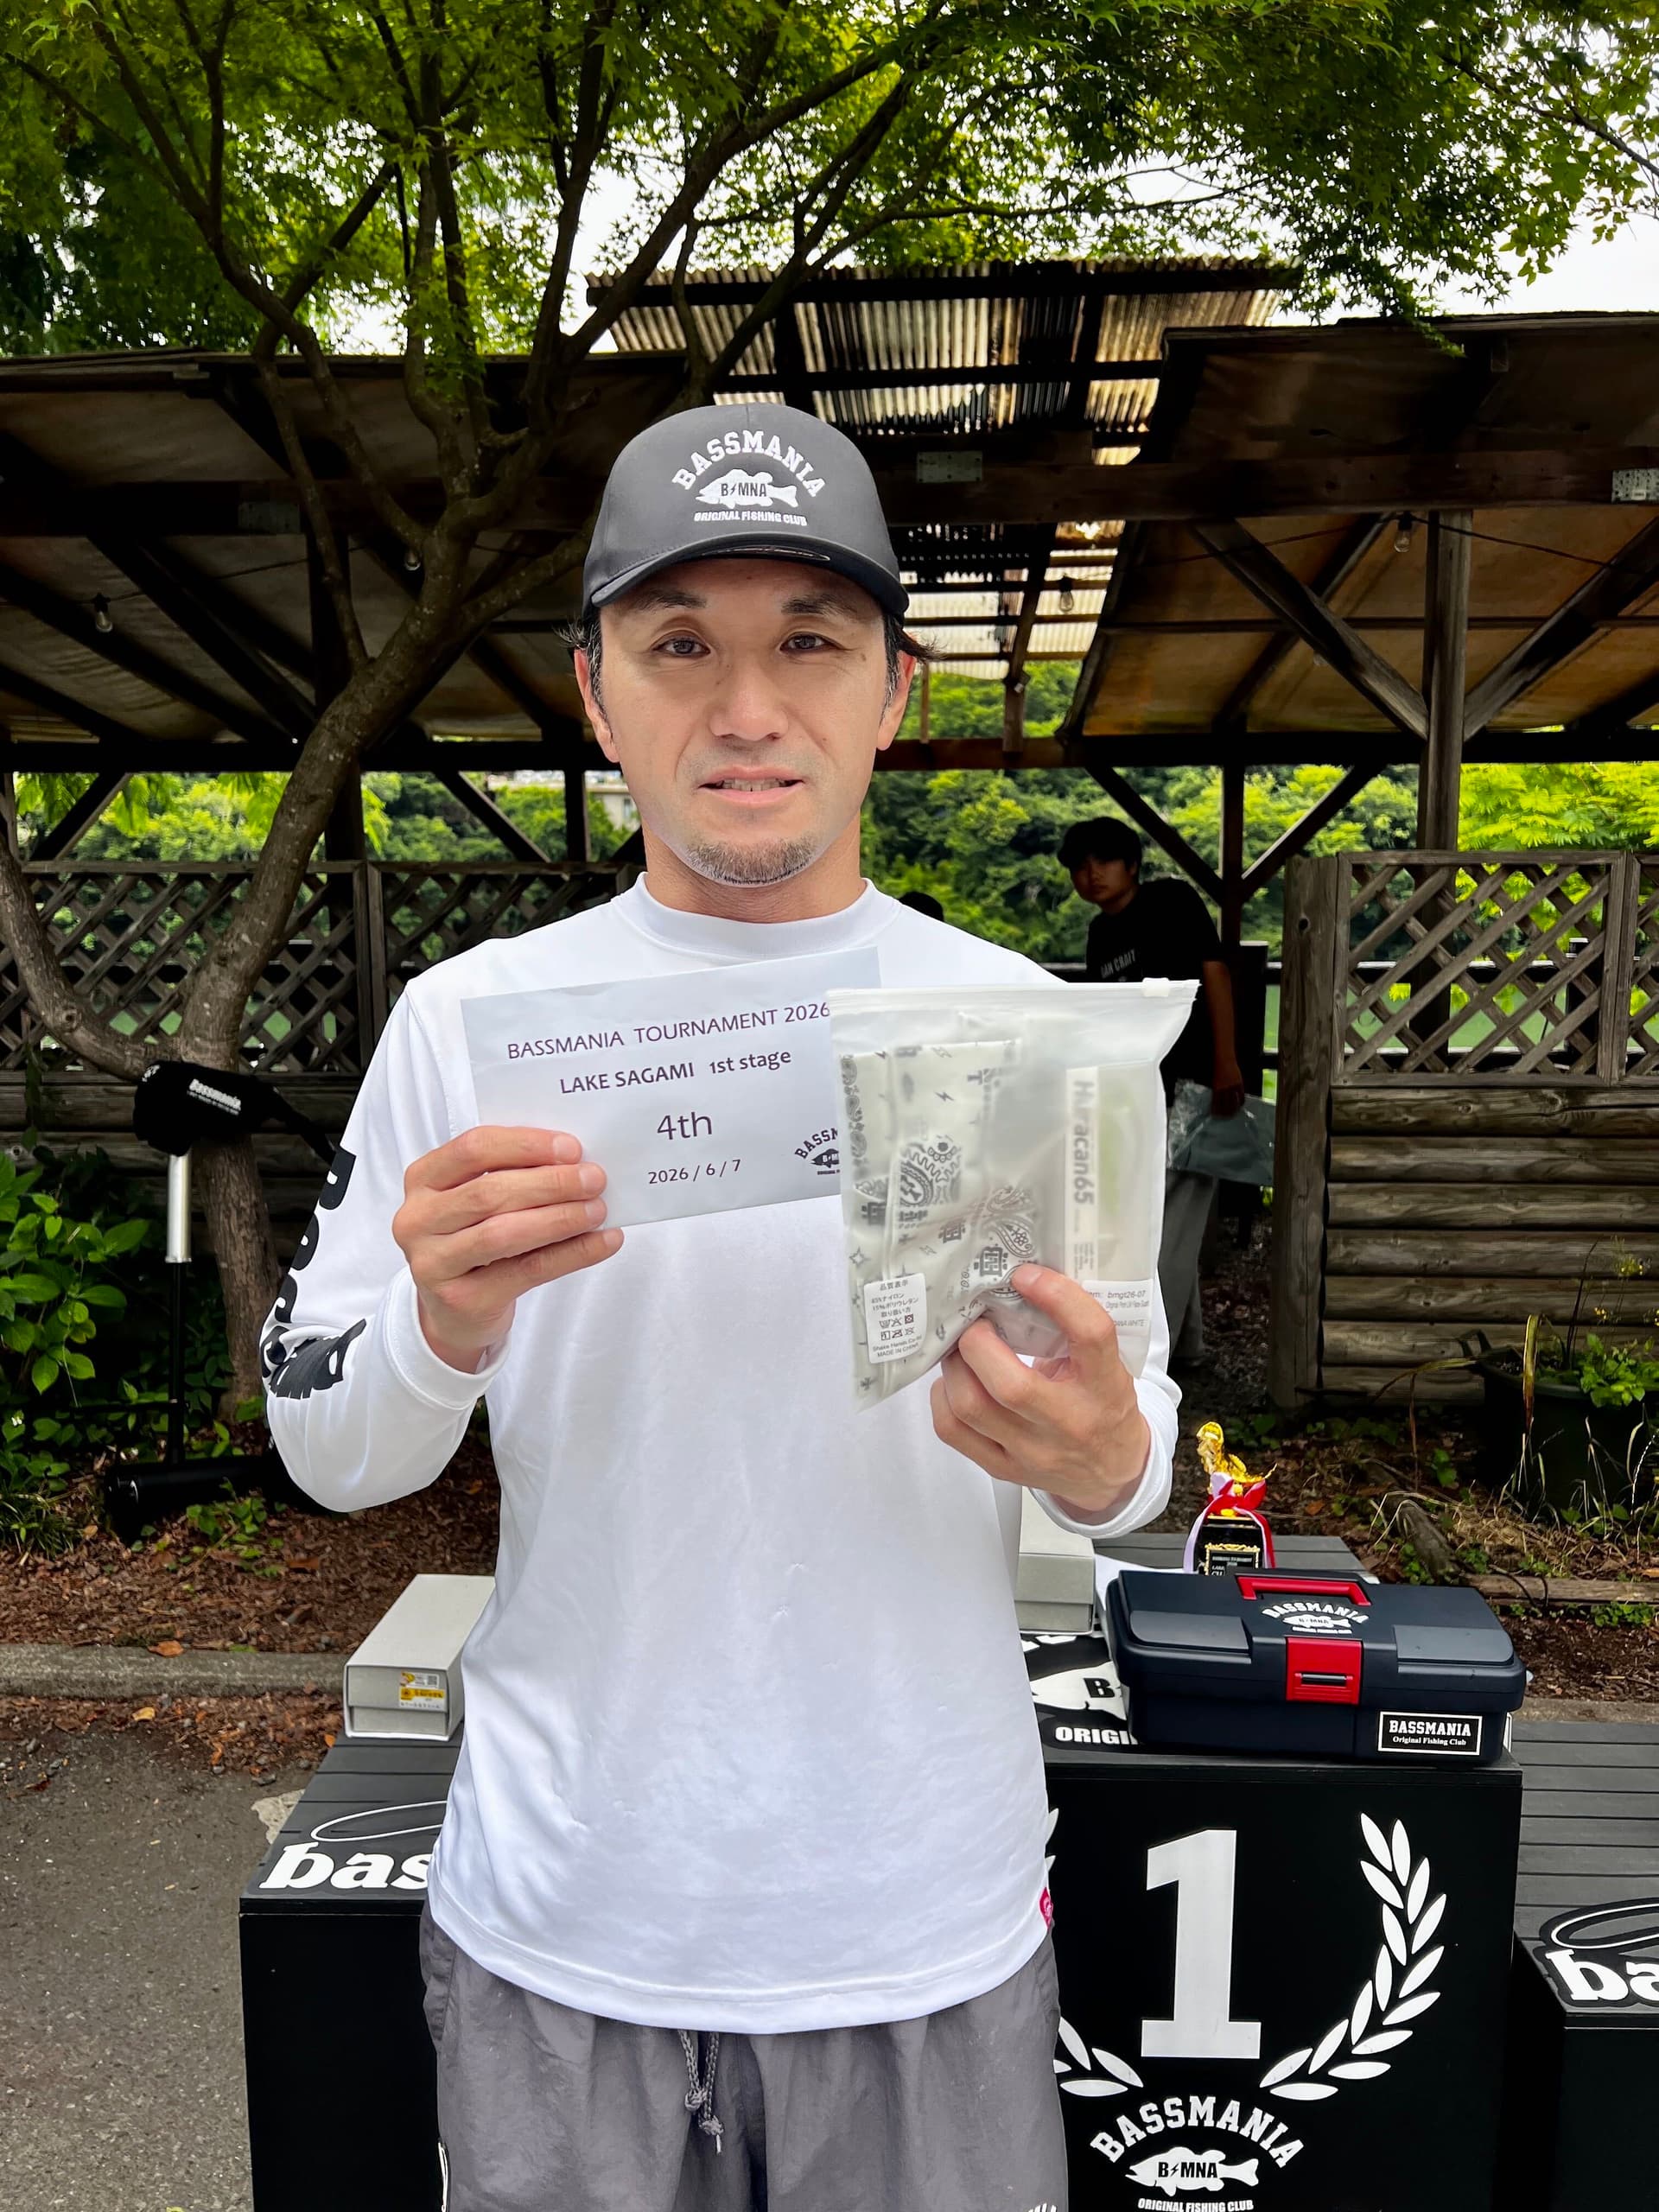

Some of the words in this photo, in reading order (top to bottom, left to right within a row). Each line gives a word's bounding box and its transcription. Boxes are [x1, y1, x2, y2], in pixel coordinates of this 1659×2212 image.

[671, 429, 826, 498] BASSMANIA
[694, 511, 741, 522] ORIGINAL
[741, 511, 782, 523] FISHING
[783, 513, 807, 526] CLUB
[507, 1031, 625, 1059] BASSMANIA
[633, 1009, 778, 1043] TOURNAMENT
[784, 1002, 830, 1023] 2026
[560, 1073, 610, 1094] LAKE
[614, 1062, 695, 1088] SAGAMI
[709, 1057, 734, 1075] 1st
[739, 1051, 791, 1071] stage
[657, 1111, 713, 1141] 4th
[647, 1167, 689, 1185] 2026
[706, 1163, 715, 1176] 6
[732, 1159, 741, 1172] 7
[1262, 1602, 1370, 1624] BASSMANIA
[1389, 1719, 1471, 1737] BASSMANIA
[1392, 1735, 1421, 1745] Original
[1422, 1737, 1449, 1746] Fishing
[1141, 1829, 1262, 2059] 1
[1090, 2095, 1304, 2168] BASSMANIA
[1137, 2197, 1185, 2212] ORIGINAL
[1185, 2202, 1226, 2212] FISHING
[1227, 2199, 1255, 2212] CLUB
